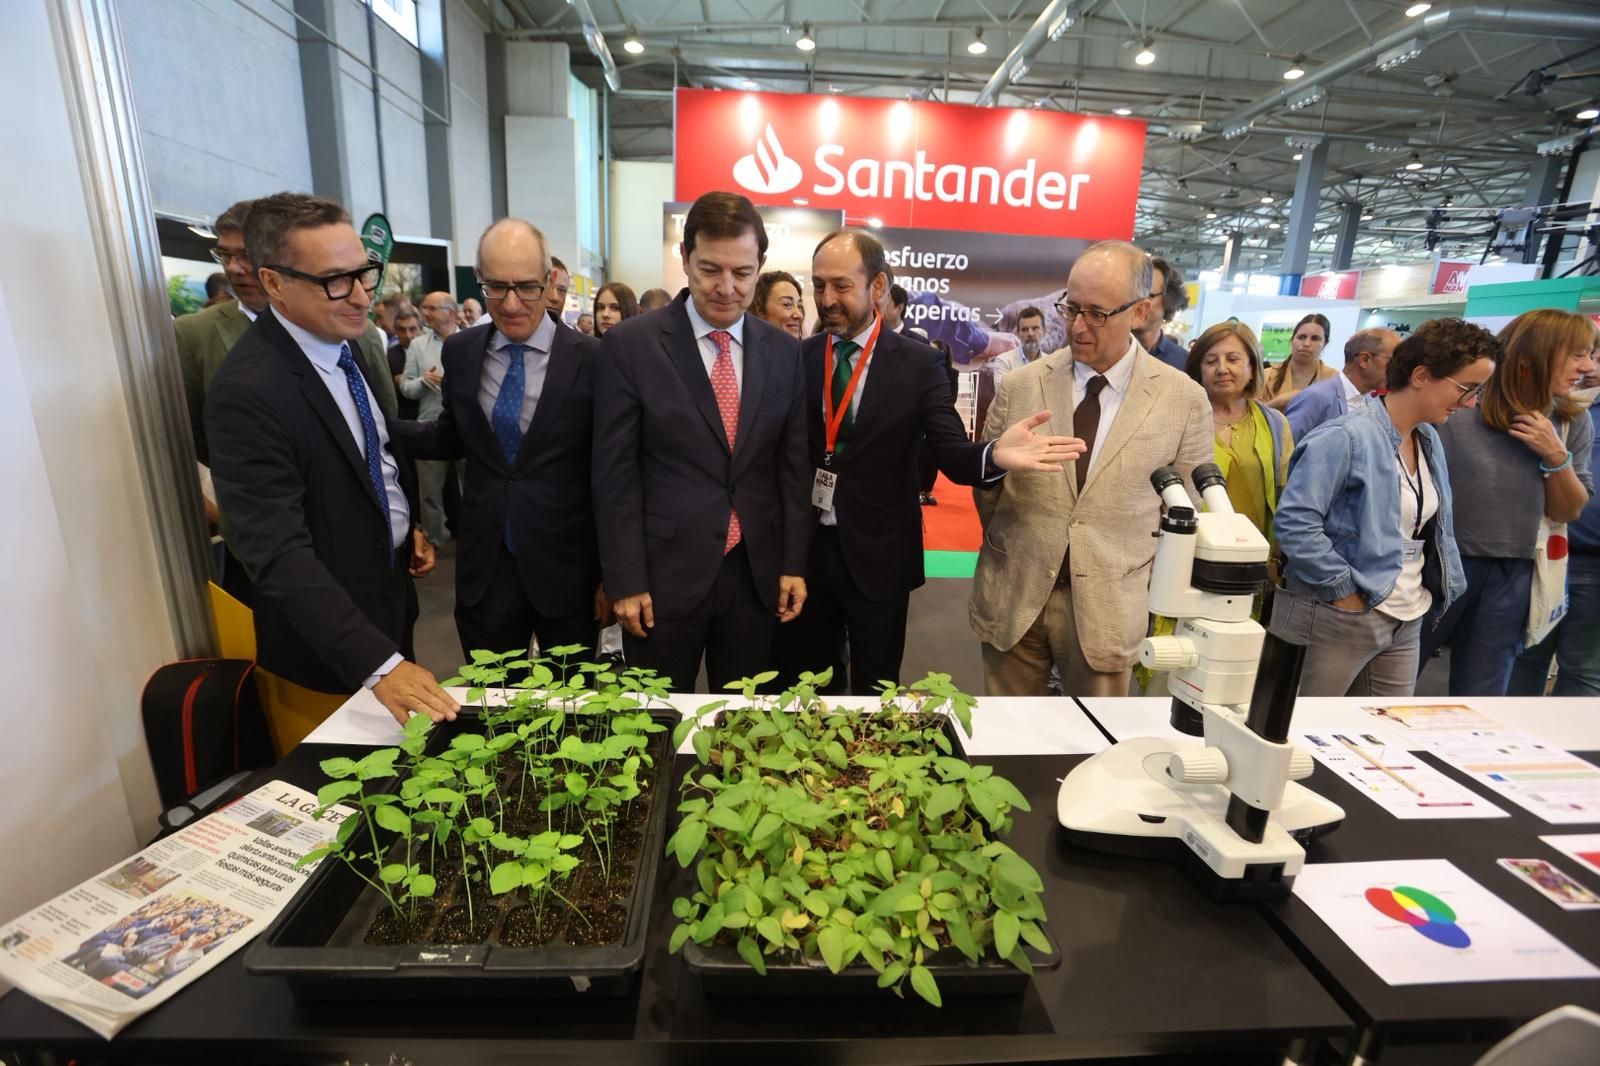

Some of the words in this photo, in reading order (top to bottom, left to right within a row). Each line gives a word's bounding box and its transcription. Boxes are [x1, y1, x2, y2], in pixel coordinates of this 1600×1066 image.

[813, 144, 1090, 211] Santander
[893, 276, 950, 293] anos
[904, 303, 981, 324] xpertas
[275, 792, 300, 809] LA
[299, 803, 348, 825] GCE
